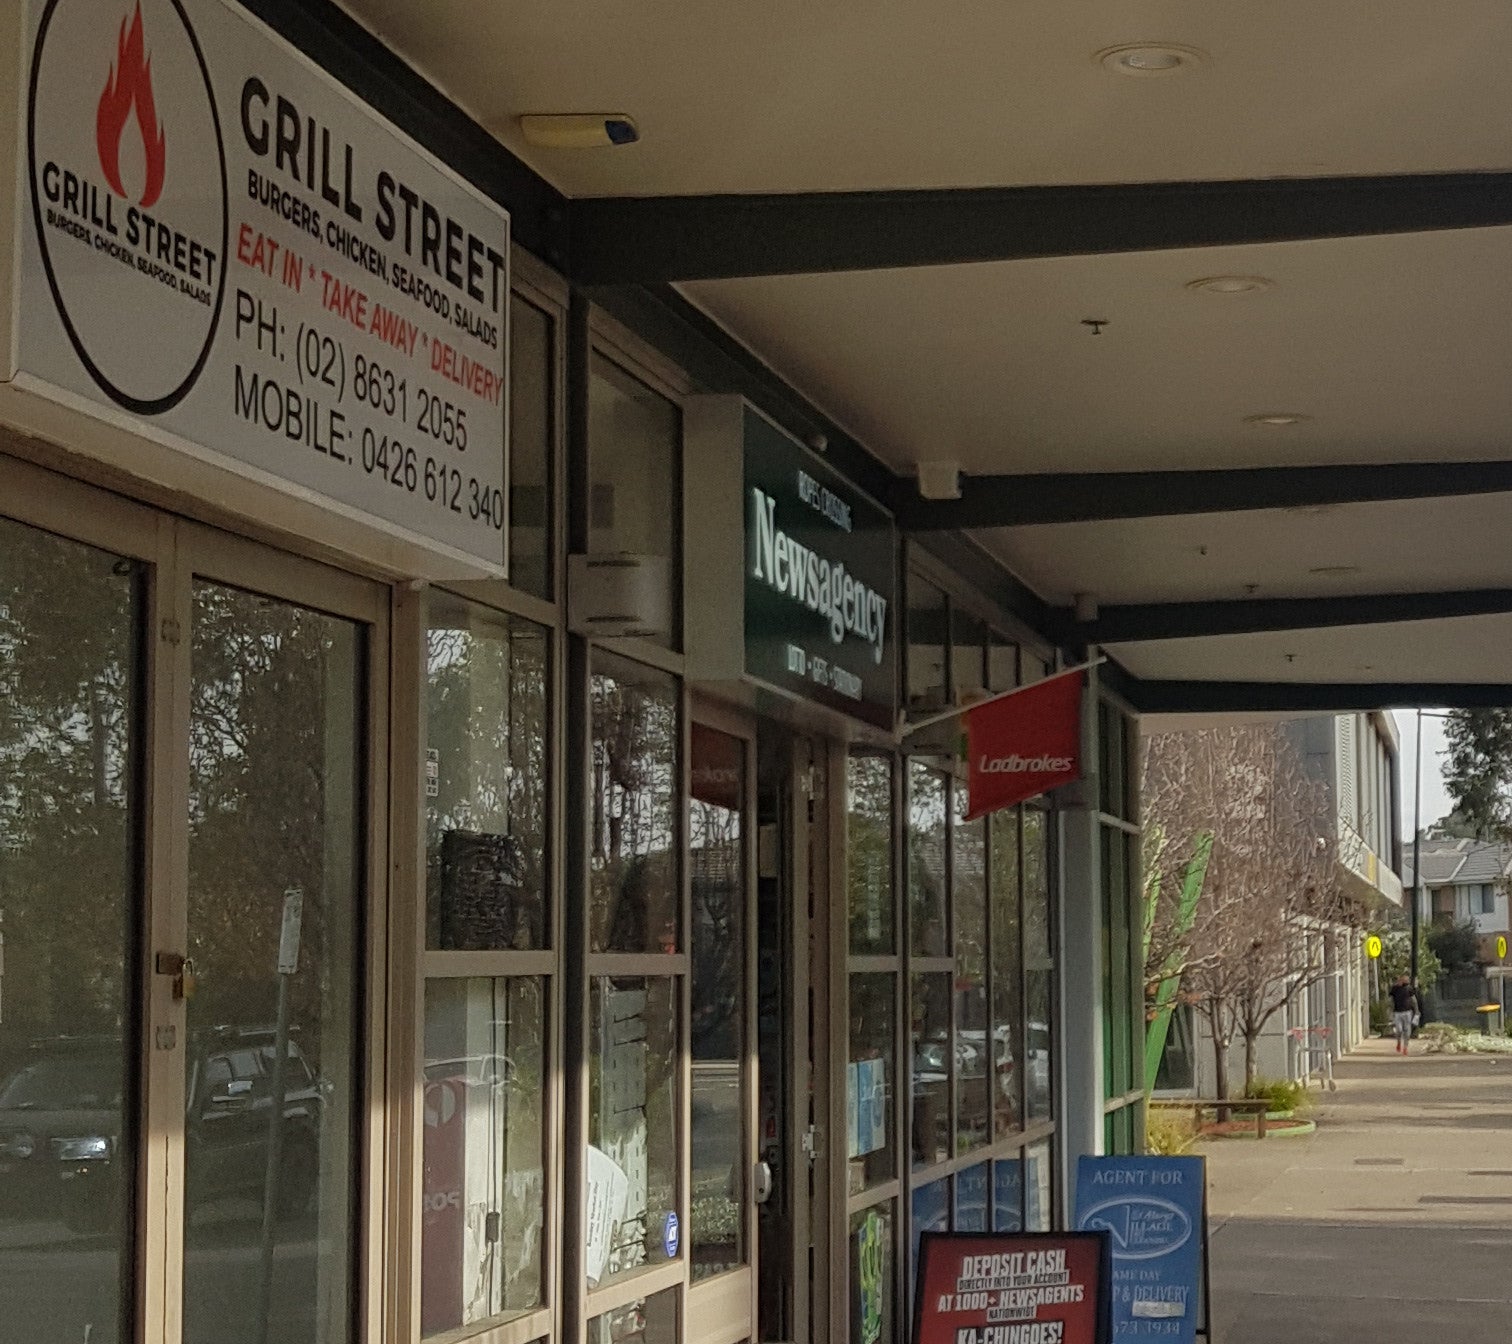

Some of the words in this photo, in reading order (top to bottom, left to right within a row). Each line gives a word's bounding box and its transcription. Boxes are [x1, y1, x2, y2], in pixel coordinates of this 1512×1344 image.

[43, 161, 118, 236] GRILL
[126, 206, 216, 286] STREET
[241, 76, 362, 223] GRILL
[375, 170, 505, 313] STREET
[248, 168, 324, 244] BURGERS,
[326, 220, 390, 286] CHICKEN,
[391, 262, 453, 325] SEAFOOD,
[454, 302, 498, 350] SALADS
[237, 222, 279, 278] EAT
[282, 249, 303, 294] IN
[321, 270, 368, 330] TAKE
[369, 303, 419, 358] AWAY
[431, 338, 504, 406] DELIVERY
[235, 288, 286, 362] PH:
[296, 322, 346, 403] (02)
[354, 354, 407, 423] 8631
[417, 388, 467, 452] 2055
[235, 364, 353, 465] MOBILE:
[362, 427, 417, 492] 0426
[425, 457, 462, 513] 612
[468, 478, 502, 531] 340
[752, 486, 887, 664] Newsagency
[980, 754, 1074, 774] Ladbrokes
[1092, 1169, 1148, 1185] AGENT
[1151, 1170, 1183, 1185] FOR
[938, 1295, 953, 1312] AT
[955, 1292, 997, 1311] 1000+
[1001, 1285, 1084, 1306] NEWSAGENTS
[962, 1253, 1024, 1278] DEPOSIT
[1026, 1249, 1067, 1274] CASH
[1113, 1269, 1135, 1281] AME
[1134, 1285, 1190, 1303] DELIVERY
[988, 1307, 1035, 1320] NATIONWIDE
